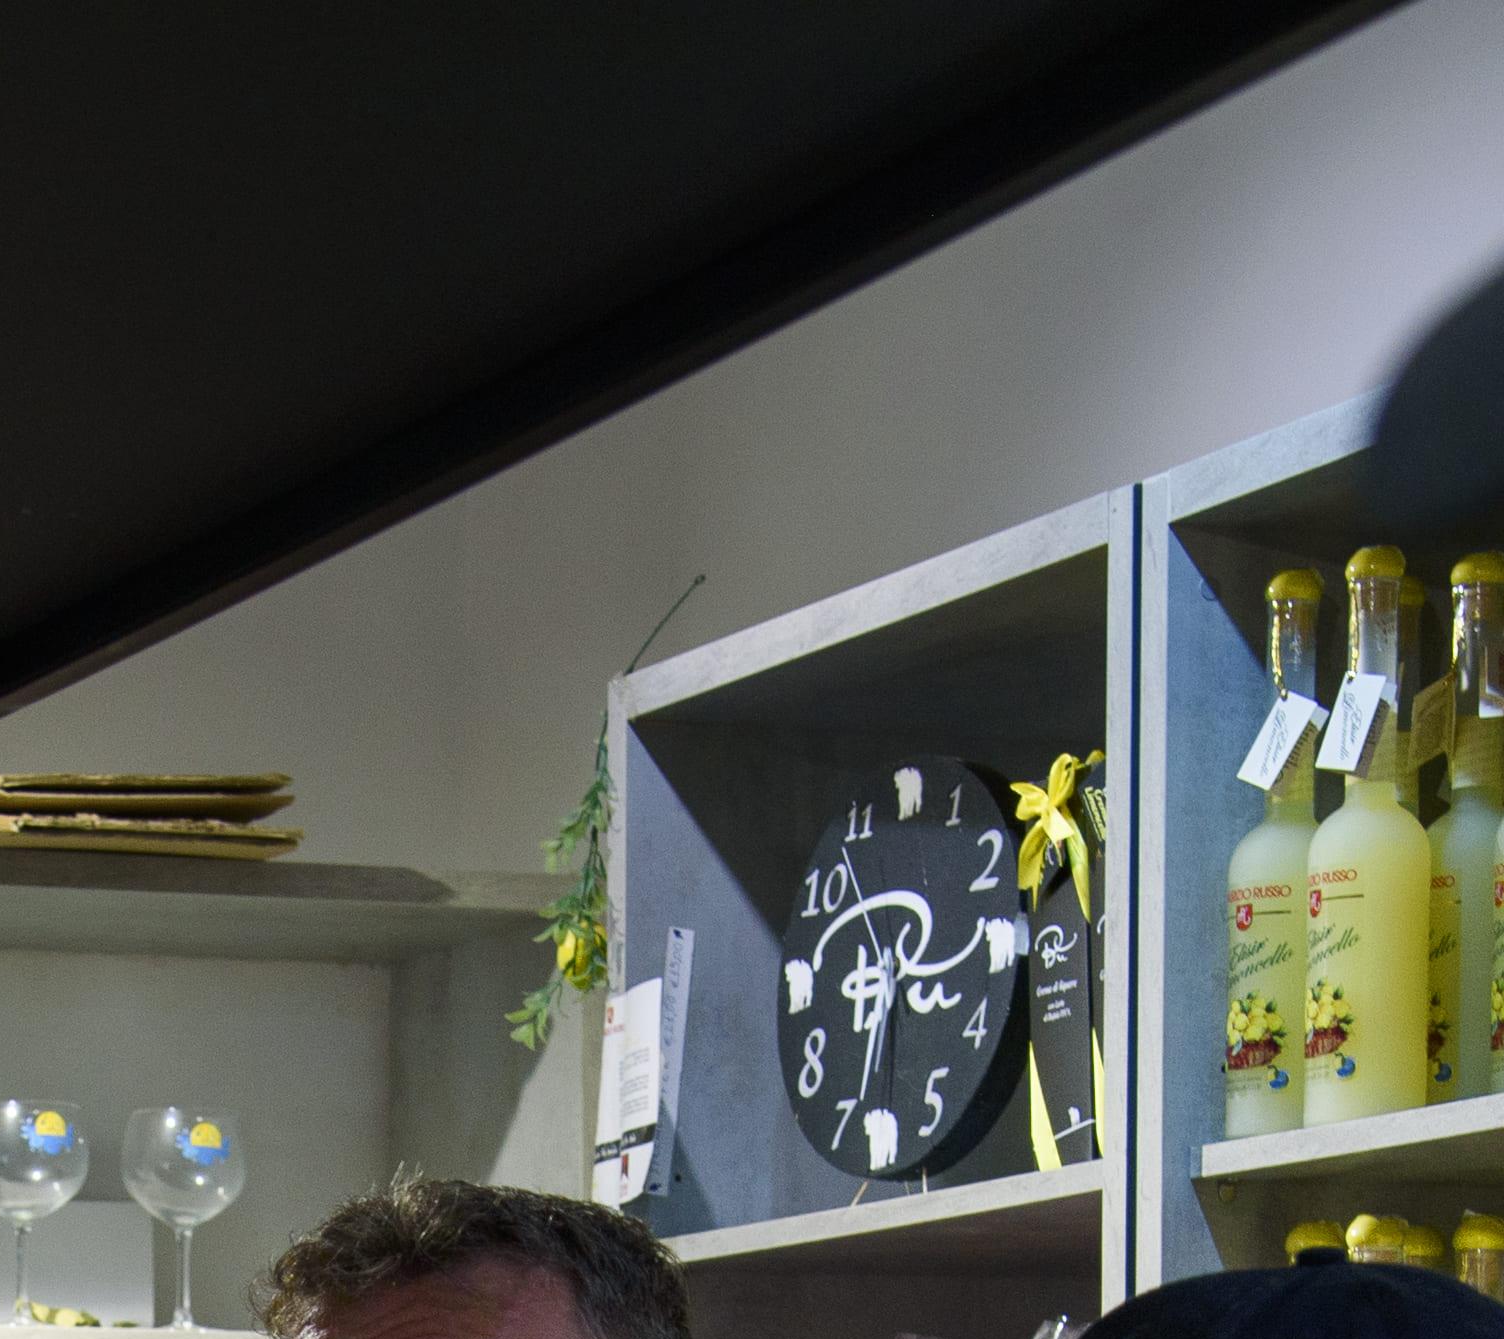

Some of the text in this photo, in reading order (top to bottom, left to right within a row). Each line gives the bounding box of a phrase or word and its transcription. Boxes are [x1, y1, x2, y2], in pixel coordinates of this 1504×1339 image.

[844, 800, 874, 842] 11
[945, 783, 964, 828] 1
[969, 828, 1004, 893] 2
[800, 862, 849, 918] 10
[962, 996, 987, 1050] 4
[798, 1026, 826, 1099] 8
[831, 1098, 857, 1151] 7
[918, 1066, 950, 1137] 5
